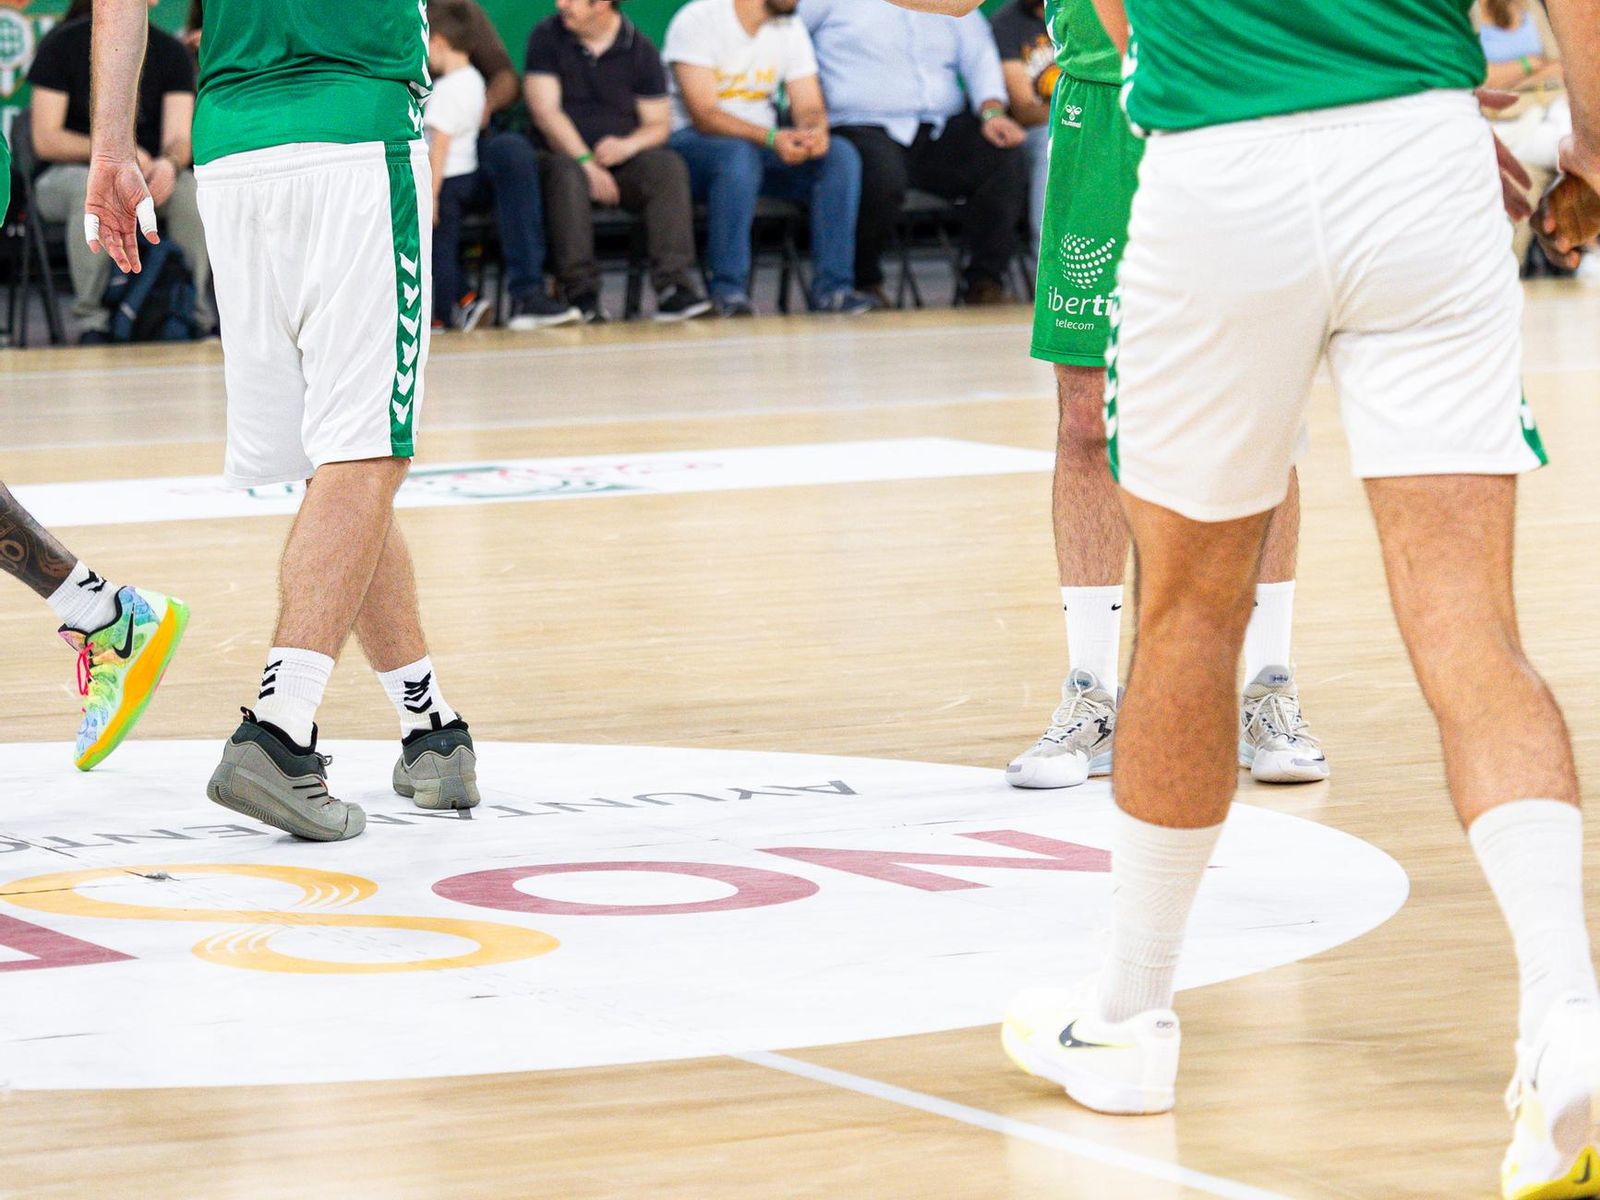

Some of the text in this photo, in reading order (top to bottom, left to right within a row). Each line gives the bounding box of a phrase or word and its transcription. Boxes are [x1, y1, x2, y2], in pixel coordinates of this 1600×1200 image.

[1048, 286, 1114, 316] iberti
[1055, 318, 1095, 331] telecom
[0, 779, 861, 854] AYUNTAENT
